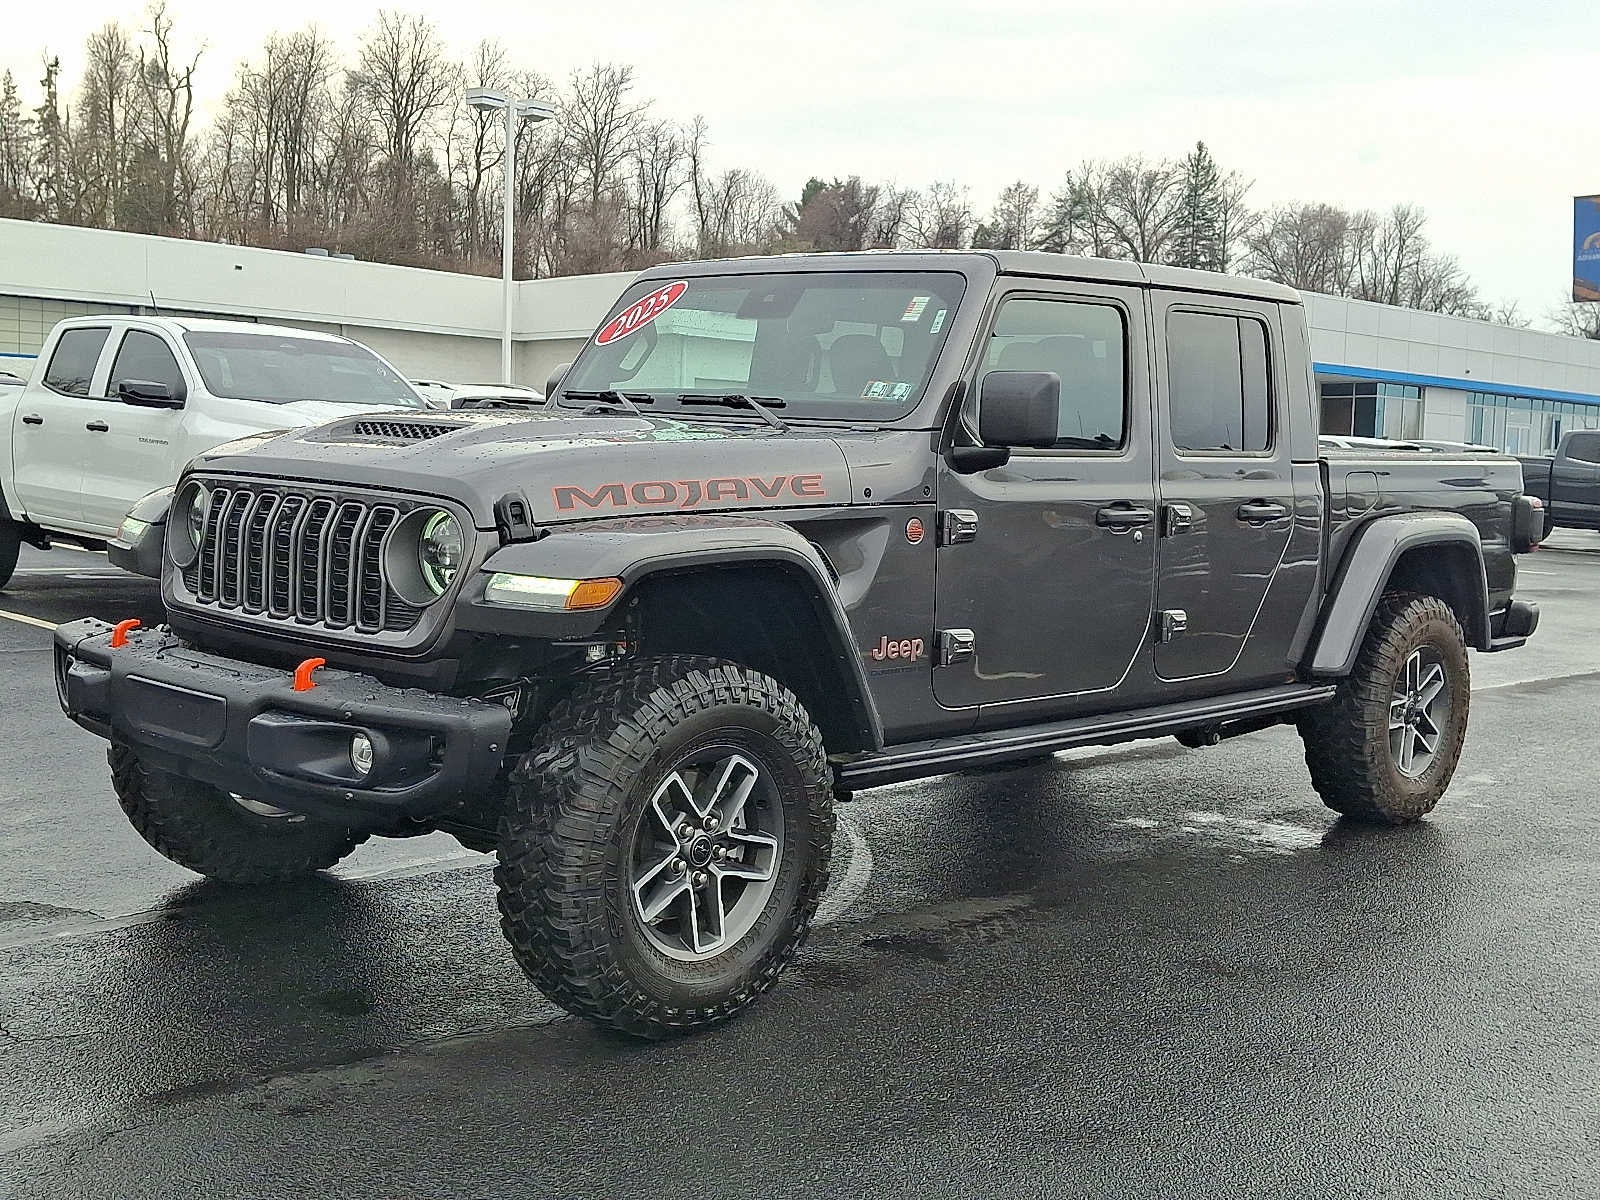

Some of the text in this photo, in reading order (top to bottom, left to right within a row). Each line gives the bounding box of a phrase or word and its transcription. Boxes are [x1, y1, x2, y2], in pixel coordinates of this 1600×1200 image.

[610, 286, 673, 340] 2025
[552, 473, 826, 510] MOJAVE
[872, 635, 924, 662] Jeep
